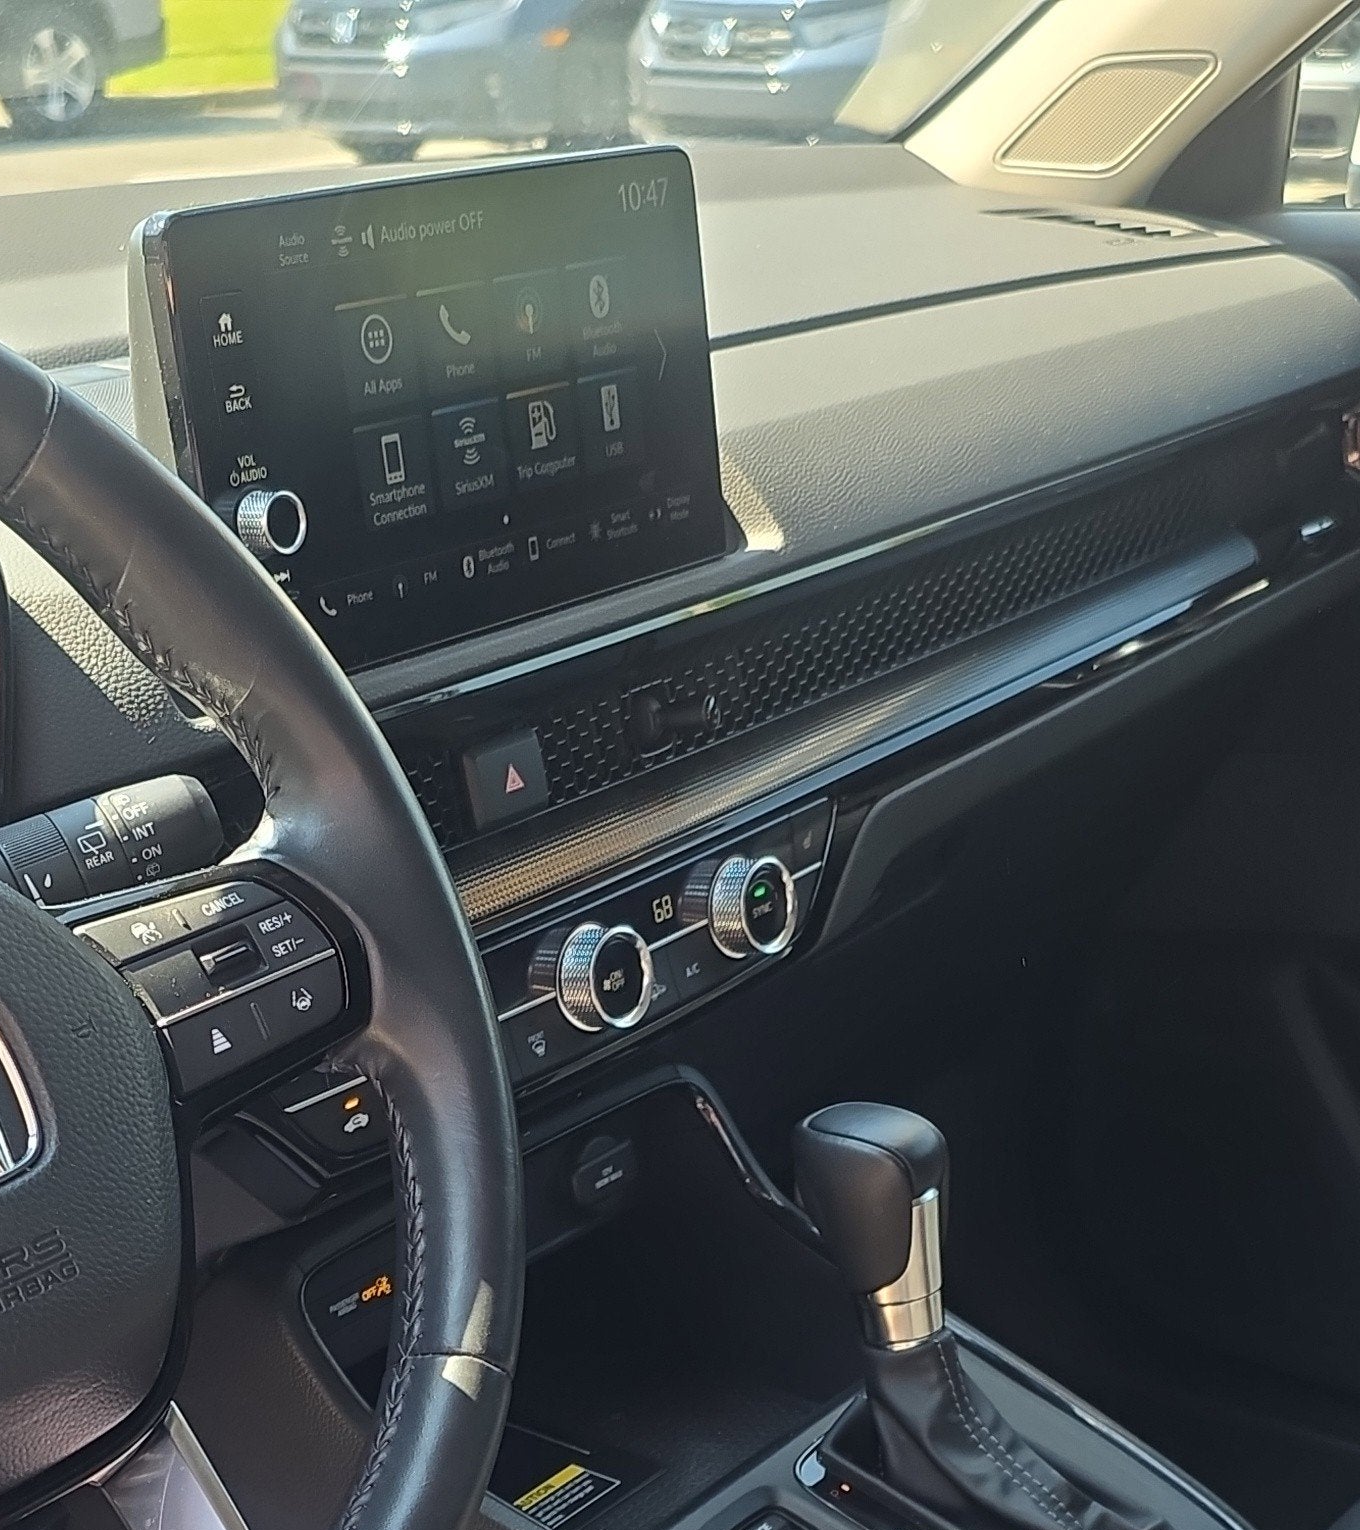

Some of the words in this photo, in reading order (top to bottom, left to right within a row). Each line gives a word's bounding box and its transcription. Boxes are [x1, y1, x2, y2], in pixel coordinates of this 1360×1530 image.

[617, 177, 668, 212] 10:47
[380, 223, 417, 243] Audio
[419, 217, 456, 241] power
[459, 210, 485, 232] OFF
[278, 232, 306, 248] Audio
[278, 250, 310, 267] Source
[212, 330, 244, 348] HOME
[525, 347, 542, 362] FM
[592, 343, 617, 359] Audio
[446, 361, 476, 379] Phone
[363, 381, 377, 396] All
[377, 377, 403, 395] Apps
[224, 395, 252, 413] BACK
[605, 441, 625, 458] USB
[237, 454, 256, 469] VOL
[516, 464, 533, 480] Trip
[534, 455, 577, 478] Computer
[240, 465, 268, 485] AUDIO
[369, 481, 427, 507] Smartphone
[454, 474, 495, 497] SiriusXM
[372, 502, 428, 527] Connection
[546, 532, 577, 550] Connect
[478, 541, 516, 562] Bluetooth
[487, 559, 511, 576] Audio
[423, 570, 439, 586] FM
[346, 589, 375, 607] Phone
[122, 802, 149, 822] OFF
[132, 822, 156, 841] INT
[84, 850, 115, 870] REAR
[141, 843, 163, 861] ON
[202, 892, 244, 917] CANCEL
[652, 894, 674, 924] 68
[258, 911, 293, 935] RES/+
[361, 1284, 378, 1302] OFF
